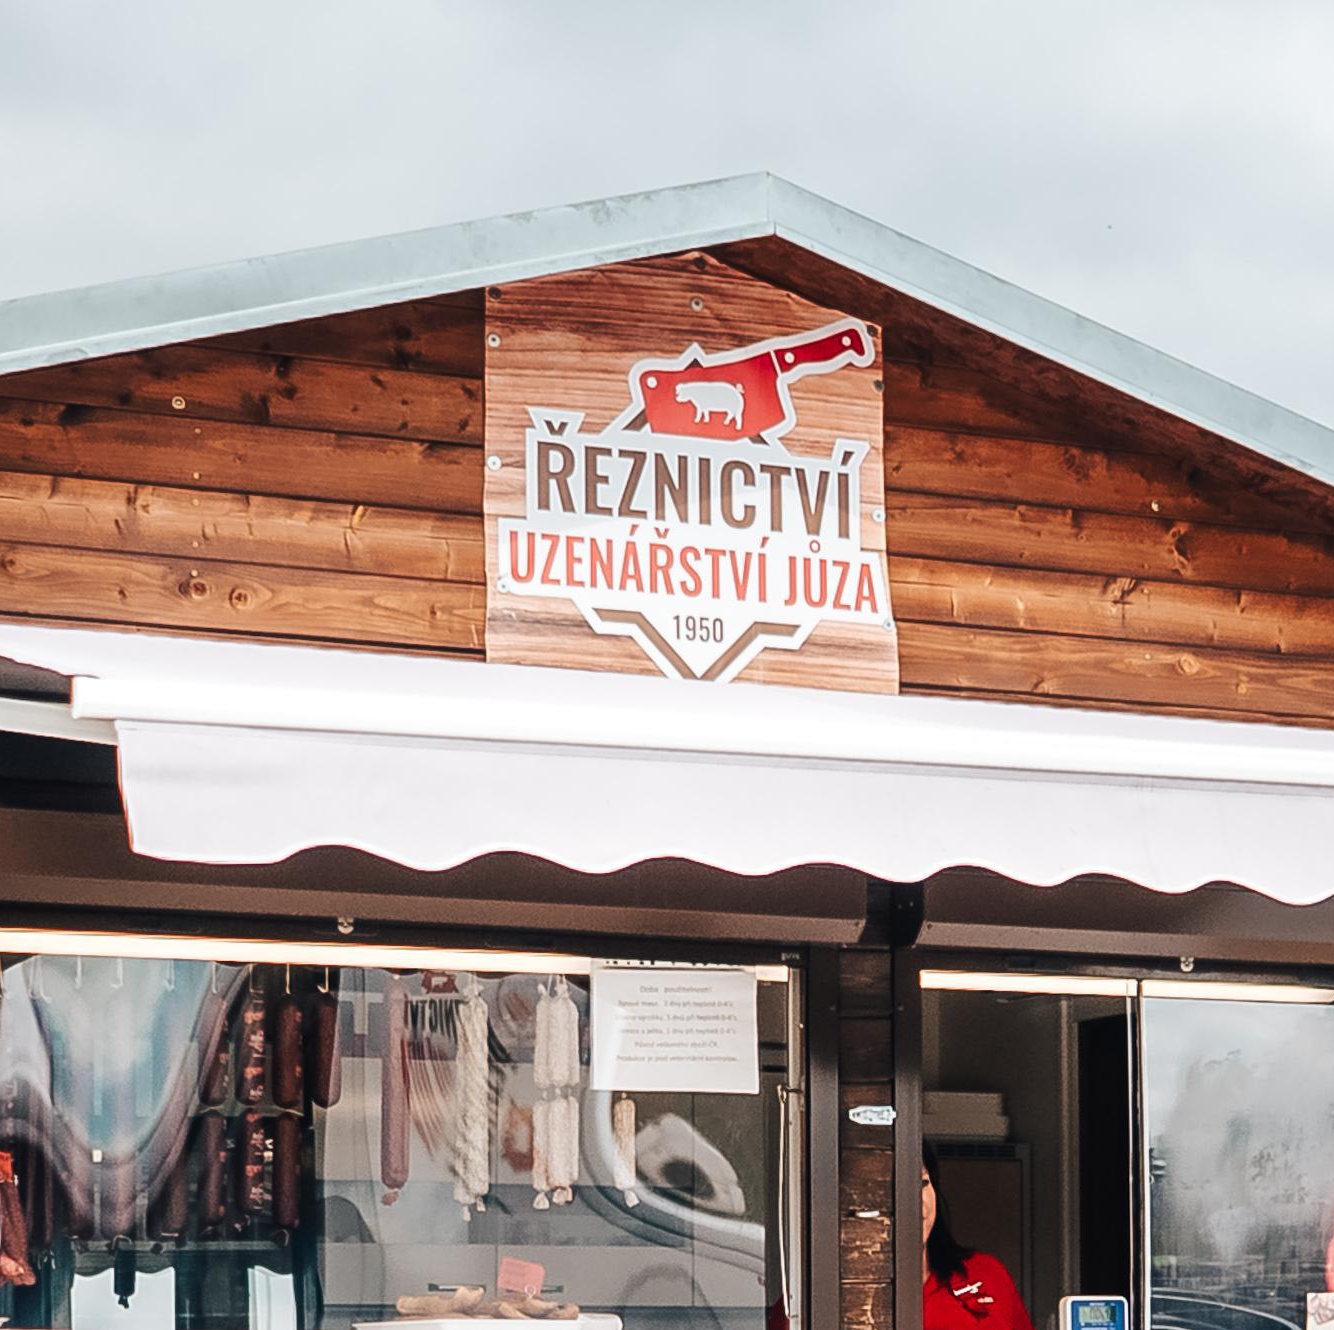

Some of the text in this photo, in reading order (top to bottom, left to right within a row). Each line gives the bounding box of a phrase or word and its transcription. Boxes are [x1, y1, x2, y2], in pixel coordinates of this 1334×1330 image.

[536, 420, 855, 540] ŘEZNICTVÍ
[509, 524, 879, 614] UZENÁŘSTVÍ JŮZA
[673, 615, 724, 643] 1950
